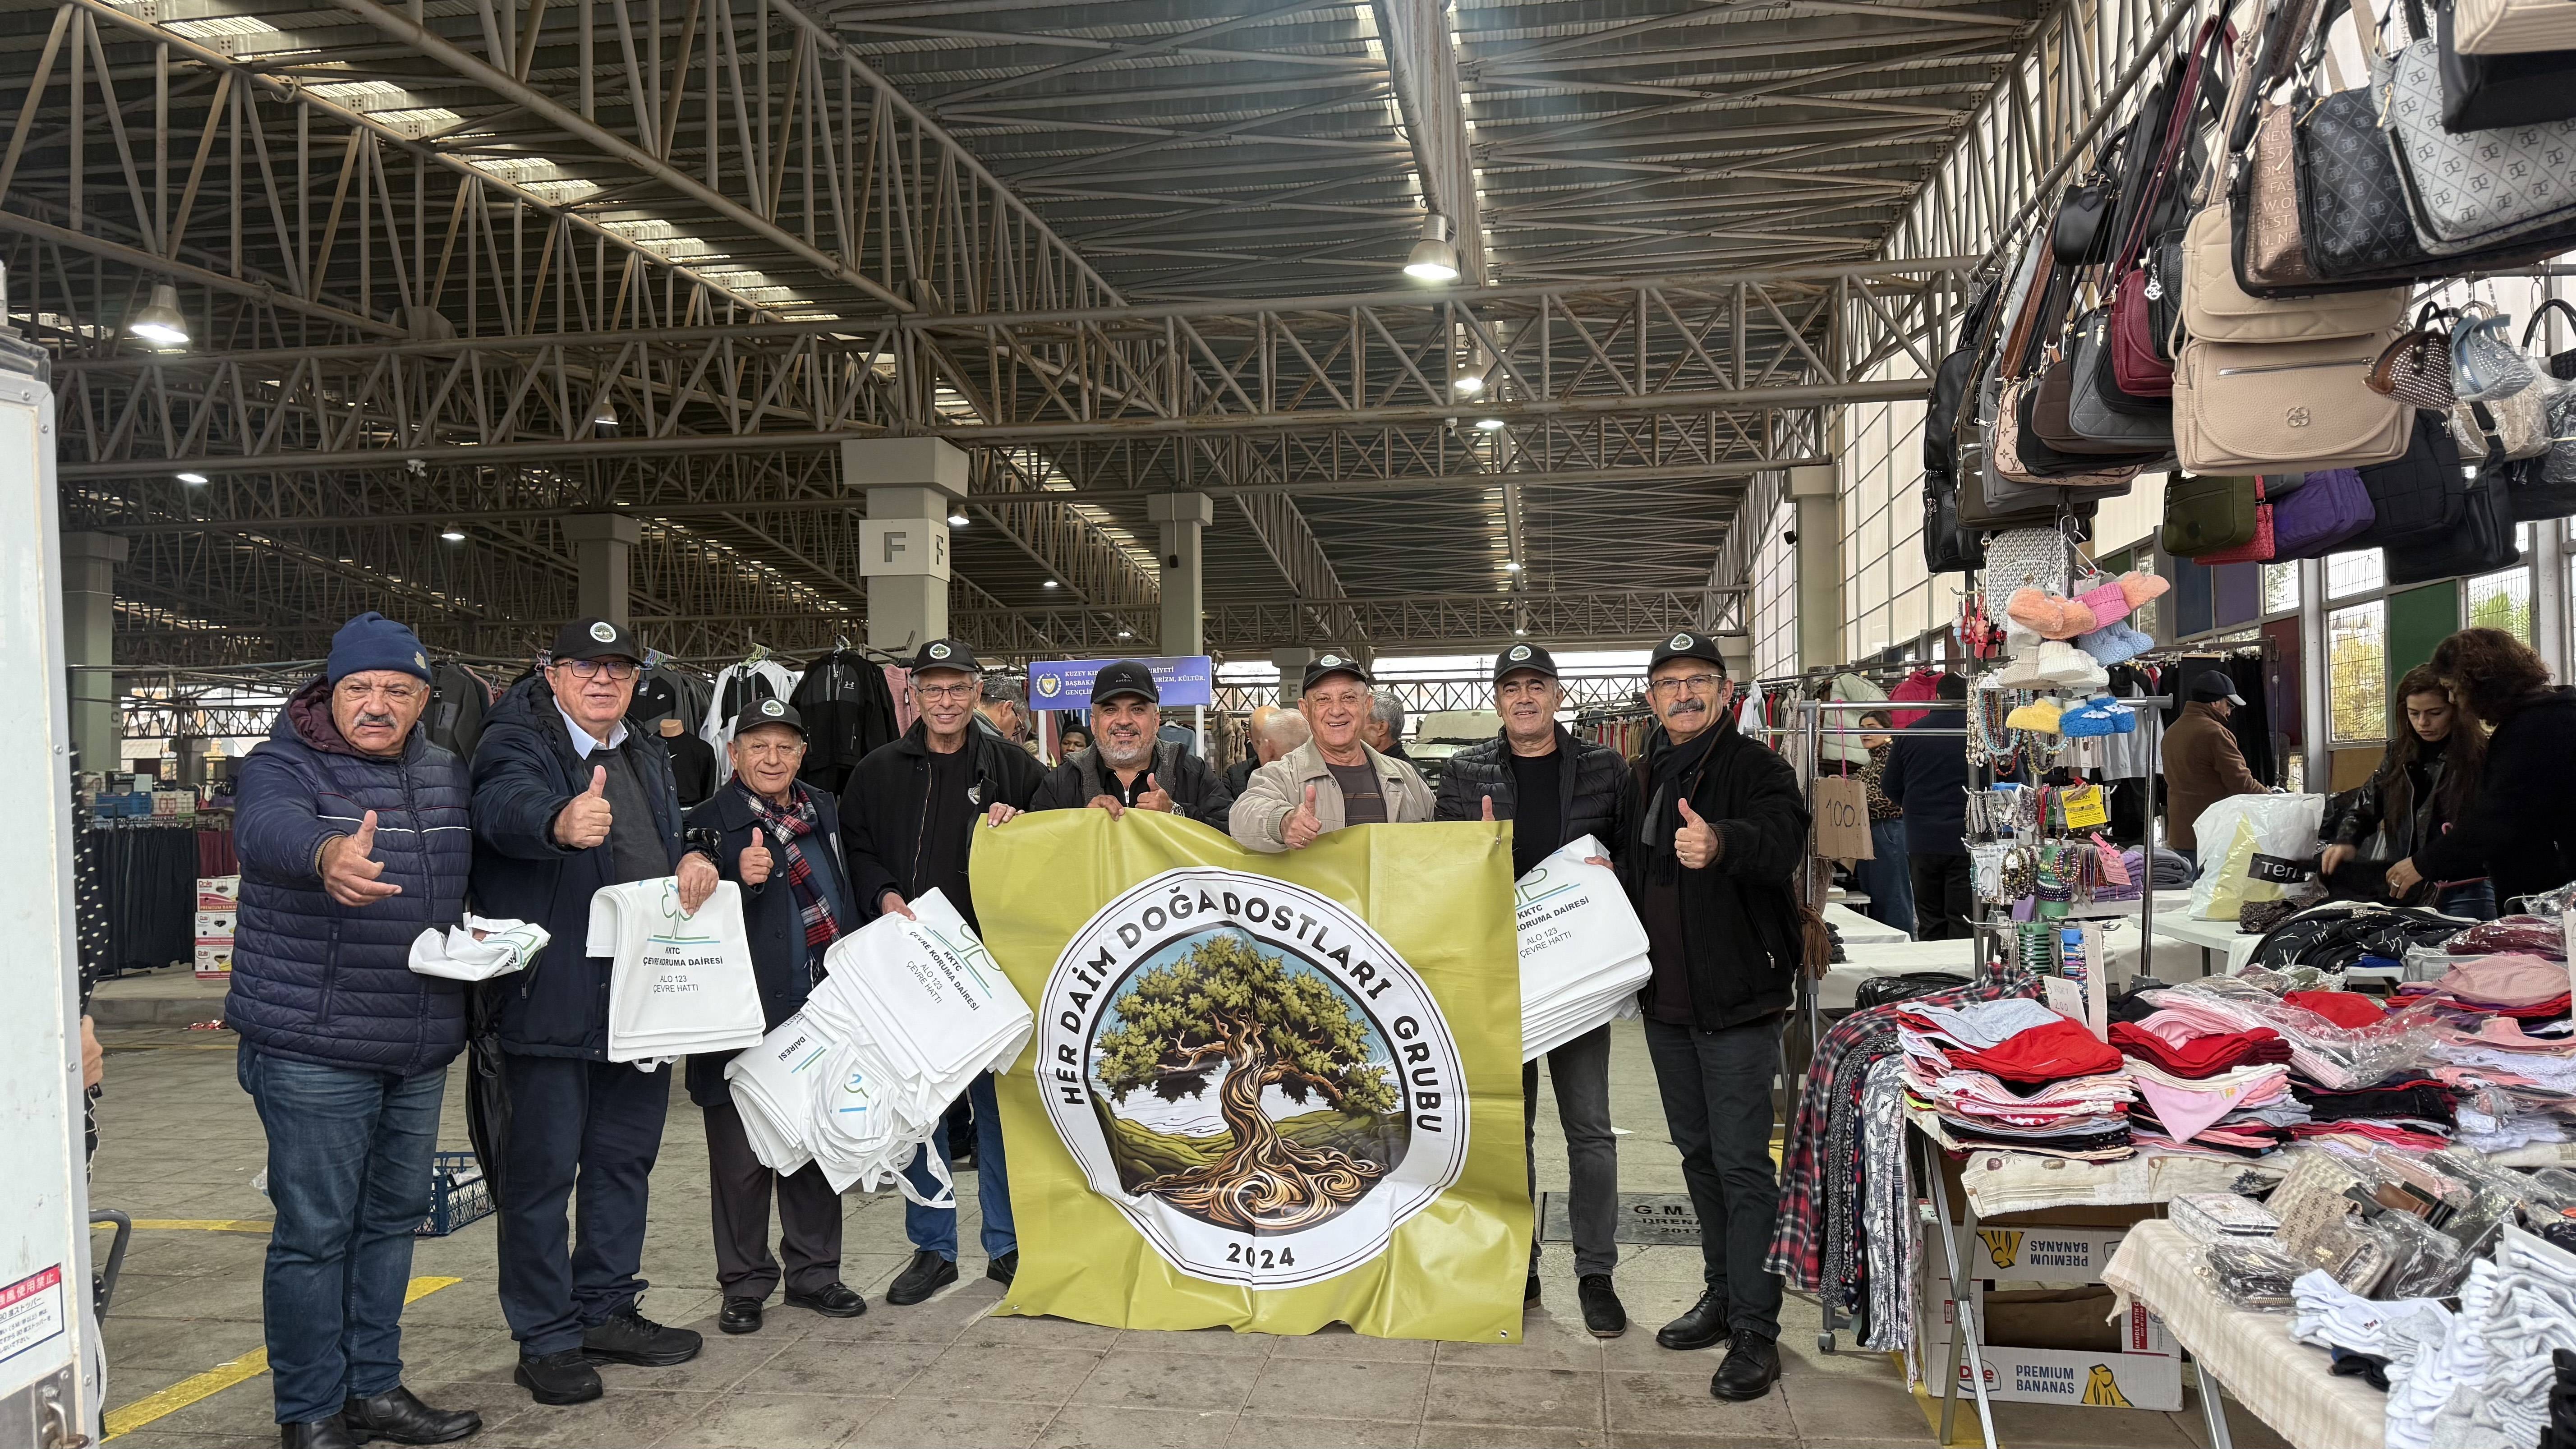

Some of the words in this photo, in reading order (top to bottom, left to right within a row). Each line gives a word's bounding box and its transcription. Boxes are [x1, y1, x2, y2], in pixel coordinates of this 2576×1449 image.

[884, 531, 906, 563] F
[936, 534, 943, 565] F
[1288, 684, 1297, 697] F
[111, 711, 119, 722] C
[1517, 904, 1543, 920] KKTC
[1553, 896, 1590, 917] DAİRESİ
[1520, 941, 1548, 959] ÇEVRE
[1548, 931, 1572, 946] HATTI
[1526, 934, 1542, 945] ALO
[1544, 927, 1558, 938] 123
[665, 946, 681, 955] KKTC
[643, 957, 659, 966] ÇEVRE
[659, 958, 686, 966] KORUMA
[688, 956, 723, 966] DAİRESİ
[943, 951, 962, 971] KKTC
[909, 931, 932, 950] ÇEVRE
[929, 949, 955, 982] KORUMA
[954, 981, 980, 1011] DAİRESİ
[920, 964, 934, 978] ALO
[932, 977, 943, 990] 123
[653, 984, 676, 994] ÇEVRE
[677, 984, 699, 992] HATTI
[906, 961, 928, 984] ÇEVRE
[924, 983, 943, 1004] HATTI
[1060, 945, 1118, 1035] DAİM
[2053, 998, 2069, 1012] 200
[1056, 1044, 1086, 1105] HER
[1393, 1015, 1442, 1133] GRUBU
[1226, 1242, 1295, 1269] 2024
[2030, 1240, 2088, 1253] BANANAS
[2030, 1254, 2088, 1266] PREMIUM
[1959, 1365, 1994, 1380] De
[2016, 1364, 2074, 1380] PREMIUM
[2016, 1379, 2075, 1394] BANANAS
